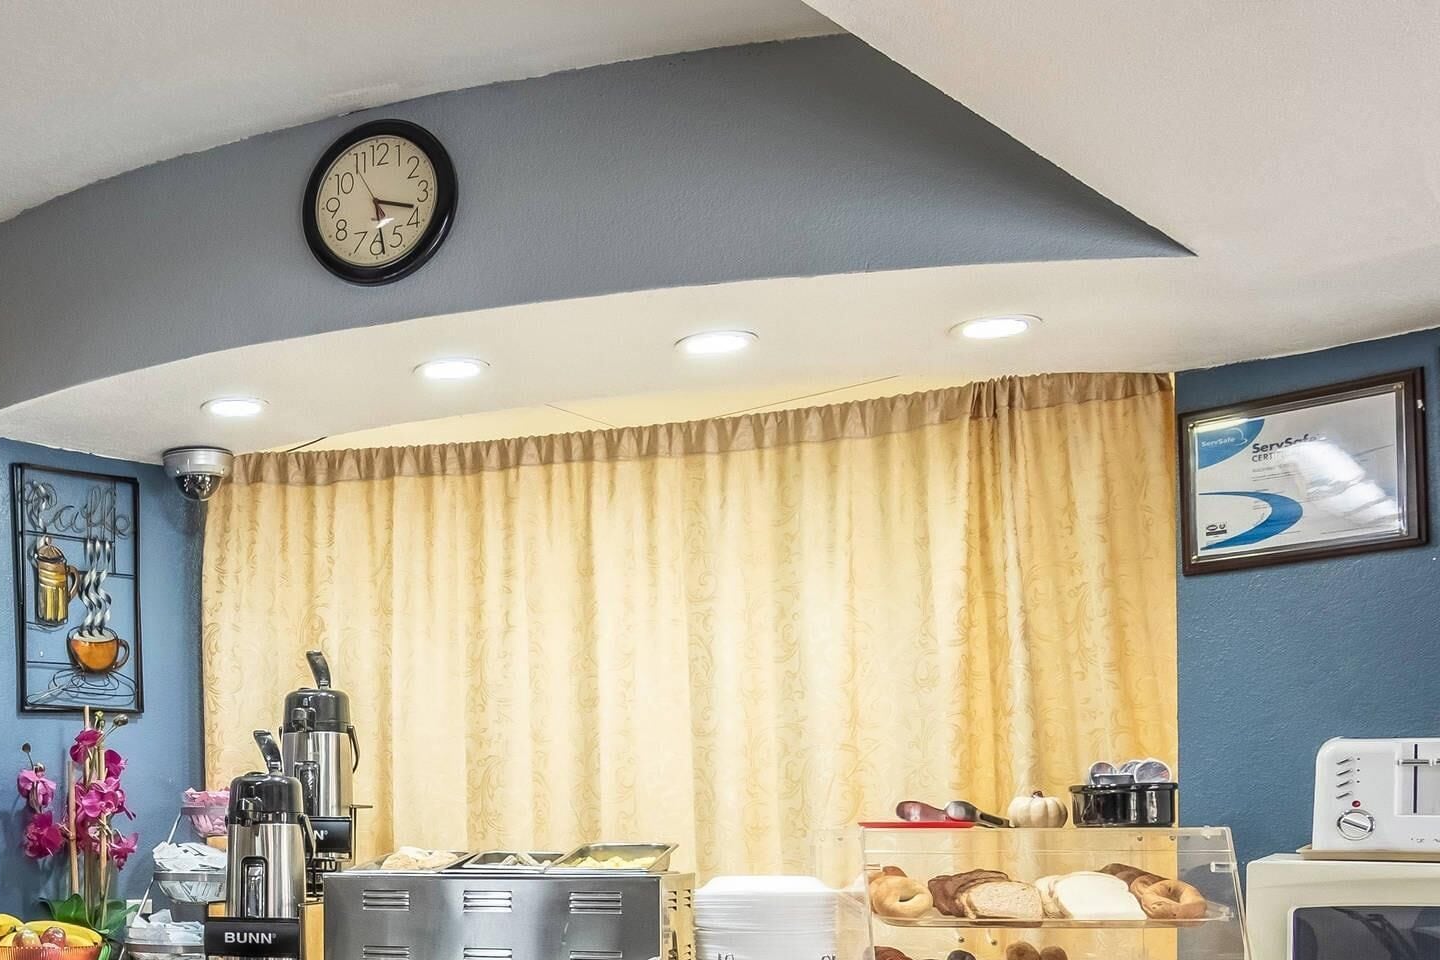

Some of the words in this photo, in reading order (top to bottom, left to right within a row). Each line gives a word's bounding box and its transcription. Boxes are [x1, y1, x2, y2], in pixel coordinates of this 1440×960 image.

[353, 152, 366, 174] 11
[370, 143, 389, 166] 12
[396, 144, 401, 166] 1
[407, 156, 420, 179] 2
[335, 172, 354, 195] 10
[417, 180, 429, 202] 3
[326, 197, 340, 219] 9
[407, 206, 420, 228] 4
[336, 219, 347, 241] 8
[390, 225, 403, 248] 5
[354, 231, 368, 254] 7
[370, 232, 384, 256] 6
[224, 932, 272, 944] BUNN
